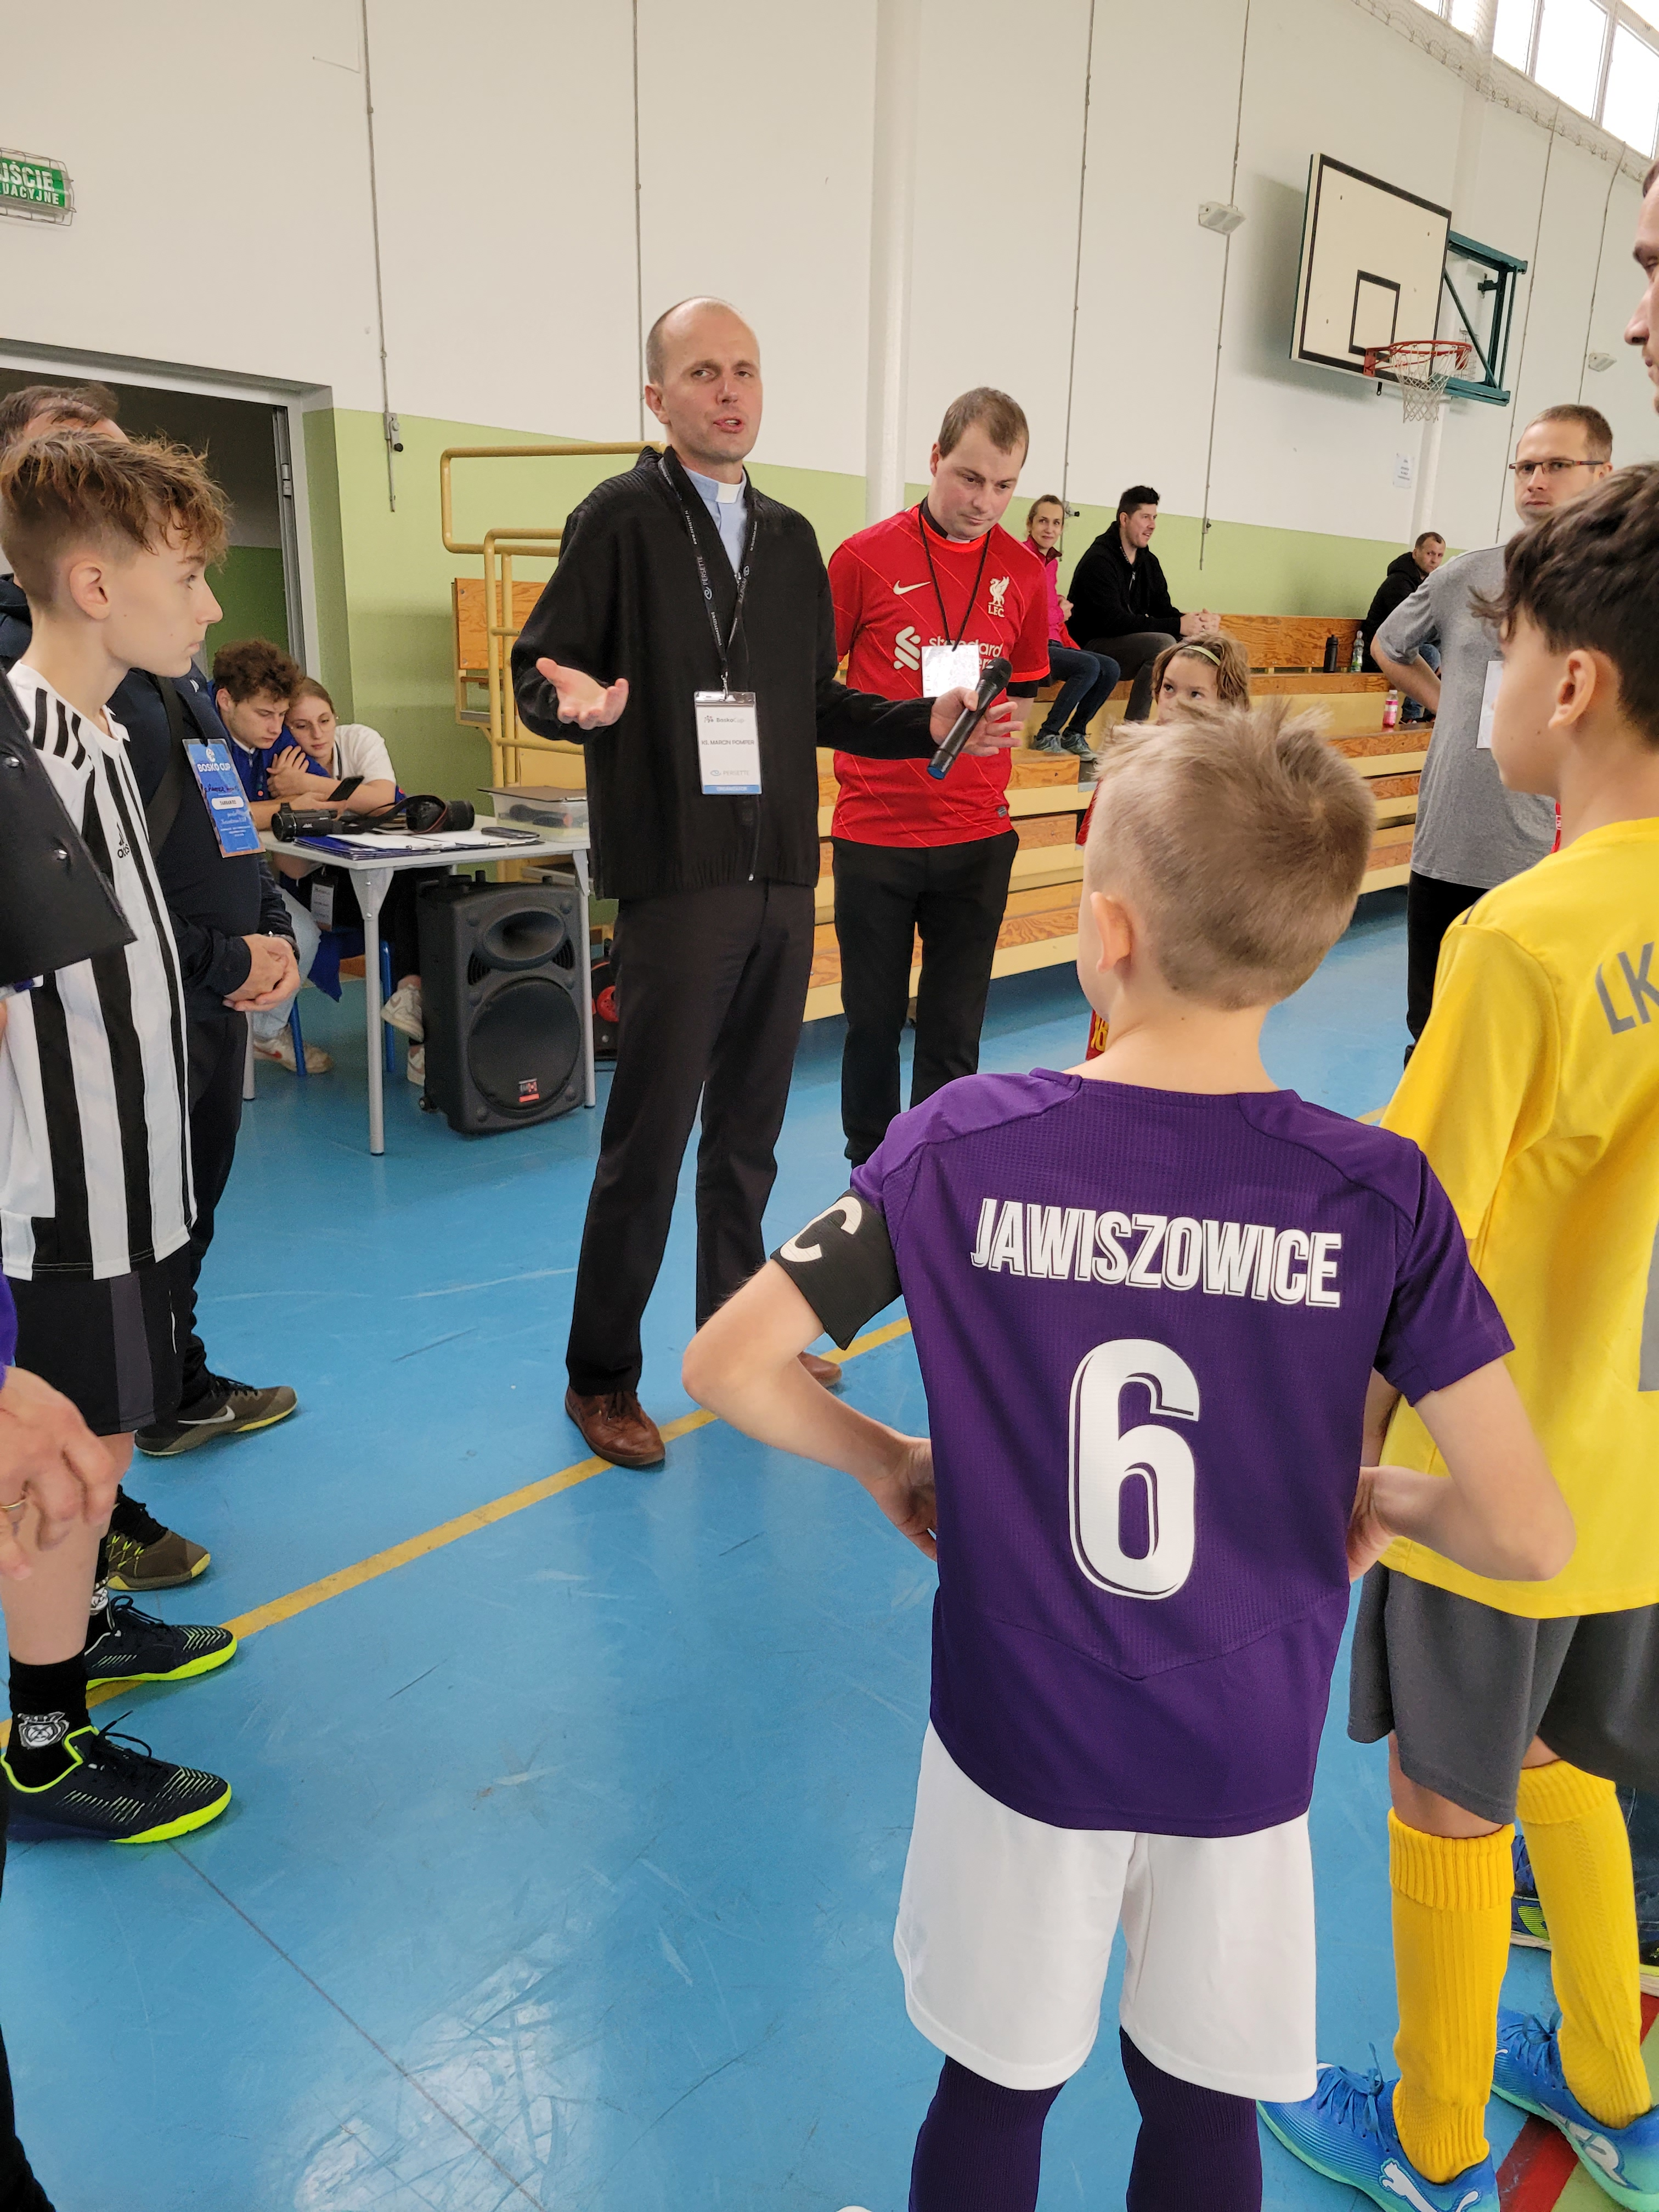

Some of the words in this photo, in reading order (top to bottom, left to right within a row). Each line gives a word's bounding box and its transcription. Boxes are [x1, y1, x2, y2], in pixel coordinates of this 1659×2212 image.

[2, 182, 59, 205] UACYJNE
[929, 635, 1003, 658] stard
[197, 763, 219, 772] BOSKO
[219, 763, 231, 771] CUP
[780, 1196, 862, 1262] C
[970, 1198, 1342, 1308] JAWISZOWICE
[1069, 1338, 1201, 1601] 6
